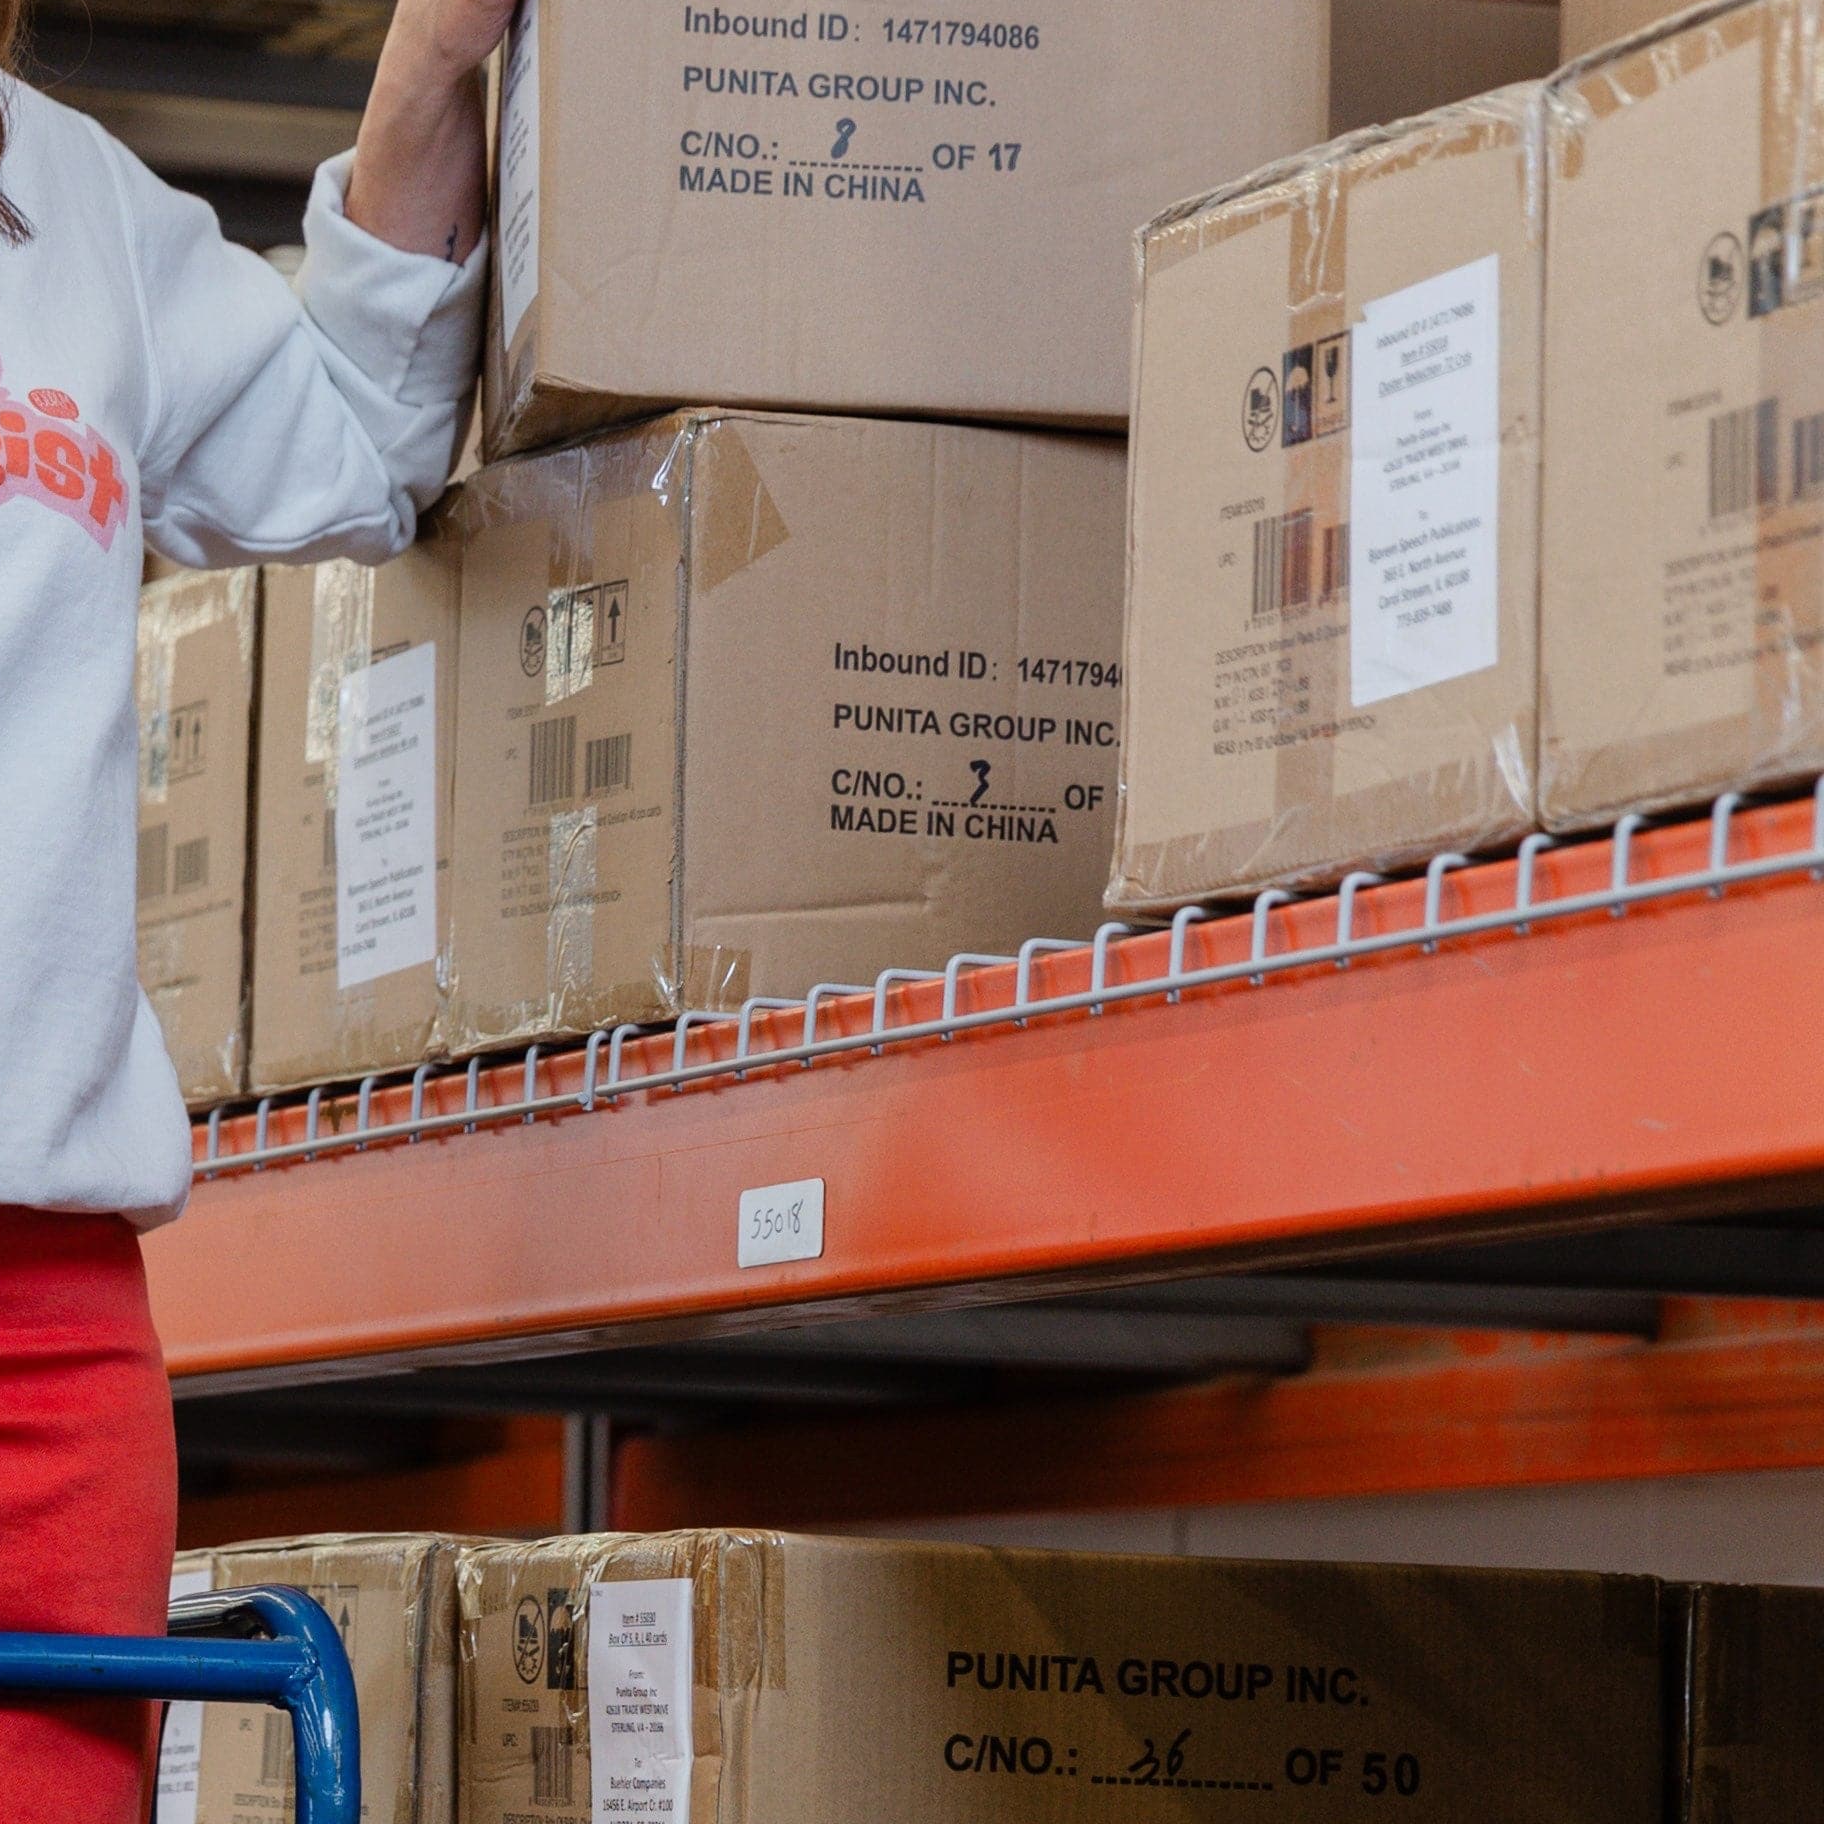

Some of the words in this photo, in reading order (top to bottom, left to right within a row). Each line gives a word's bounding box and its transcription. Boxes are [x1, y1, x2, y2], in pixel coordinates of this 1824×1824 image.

[684, 6, 807, 39] Inbound
[883, 19, 1040, 49] 1471794086
[683, 66, 798, 97] PUNITA
[809, 74, 923, 102] GROUP
[935, 79, 996, 106] INC.
[681, 131, 777, 160] C/NO.:
[933, 144, 975, 170] OF
[988, 143, 1021, 170] 17
[680, 166, 772, 195] MADE
[784, 173, 813, 196] IN
[825, 174, 924, 202] CHINA
[834, 643, 948, 676] Inbound
[1017, 657, 1122, 688] 1471794
[834, 704, 941, 734] PUNITA
[950, 712, 1056, 741] GROUP
[1066, 719, 1121, 747] INC.
[832, 769, 922, 800] C/NO.:
[1065, 785, 1103, 811] OF
[831, 804, 917, 834] MADE
[928, 811, 954, 836] IN
[965, 815, 1057, 843] CHINA
[752, 1199, 803, 1239] 55018
[946, 1651, 1105, 1694] PUNITA
[1118, 1659, 1274, 1700] GROUP
[1286, 1666, 1369, 1706] INC.
[943, 1734, 1077, 1776] C/NO.:
[1285, 1748, 1343, 1785] OF
[1362, 1753, 1420, 1797] 50
